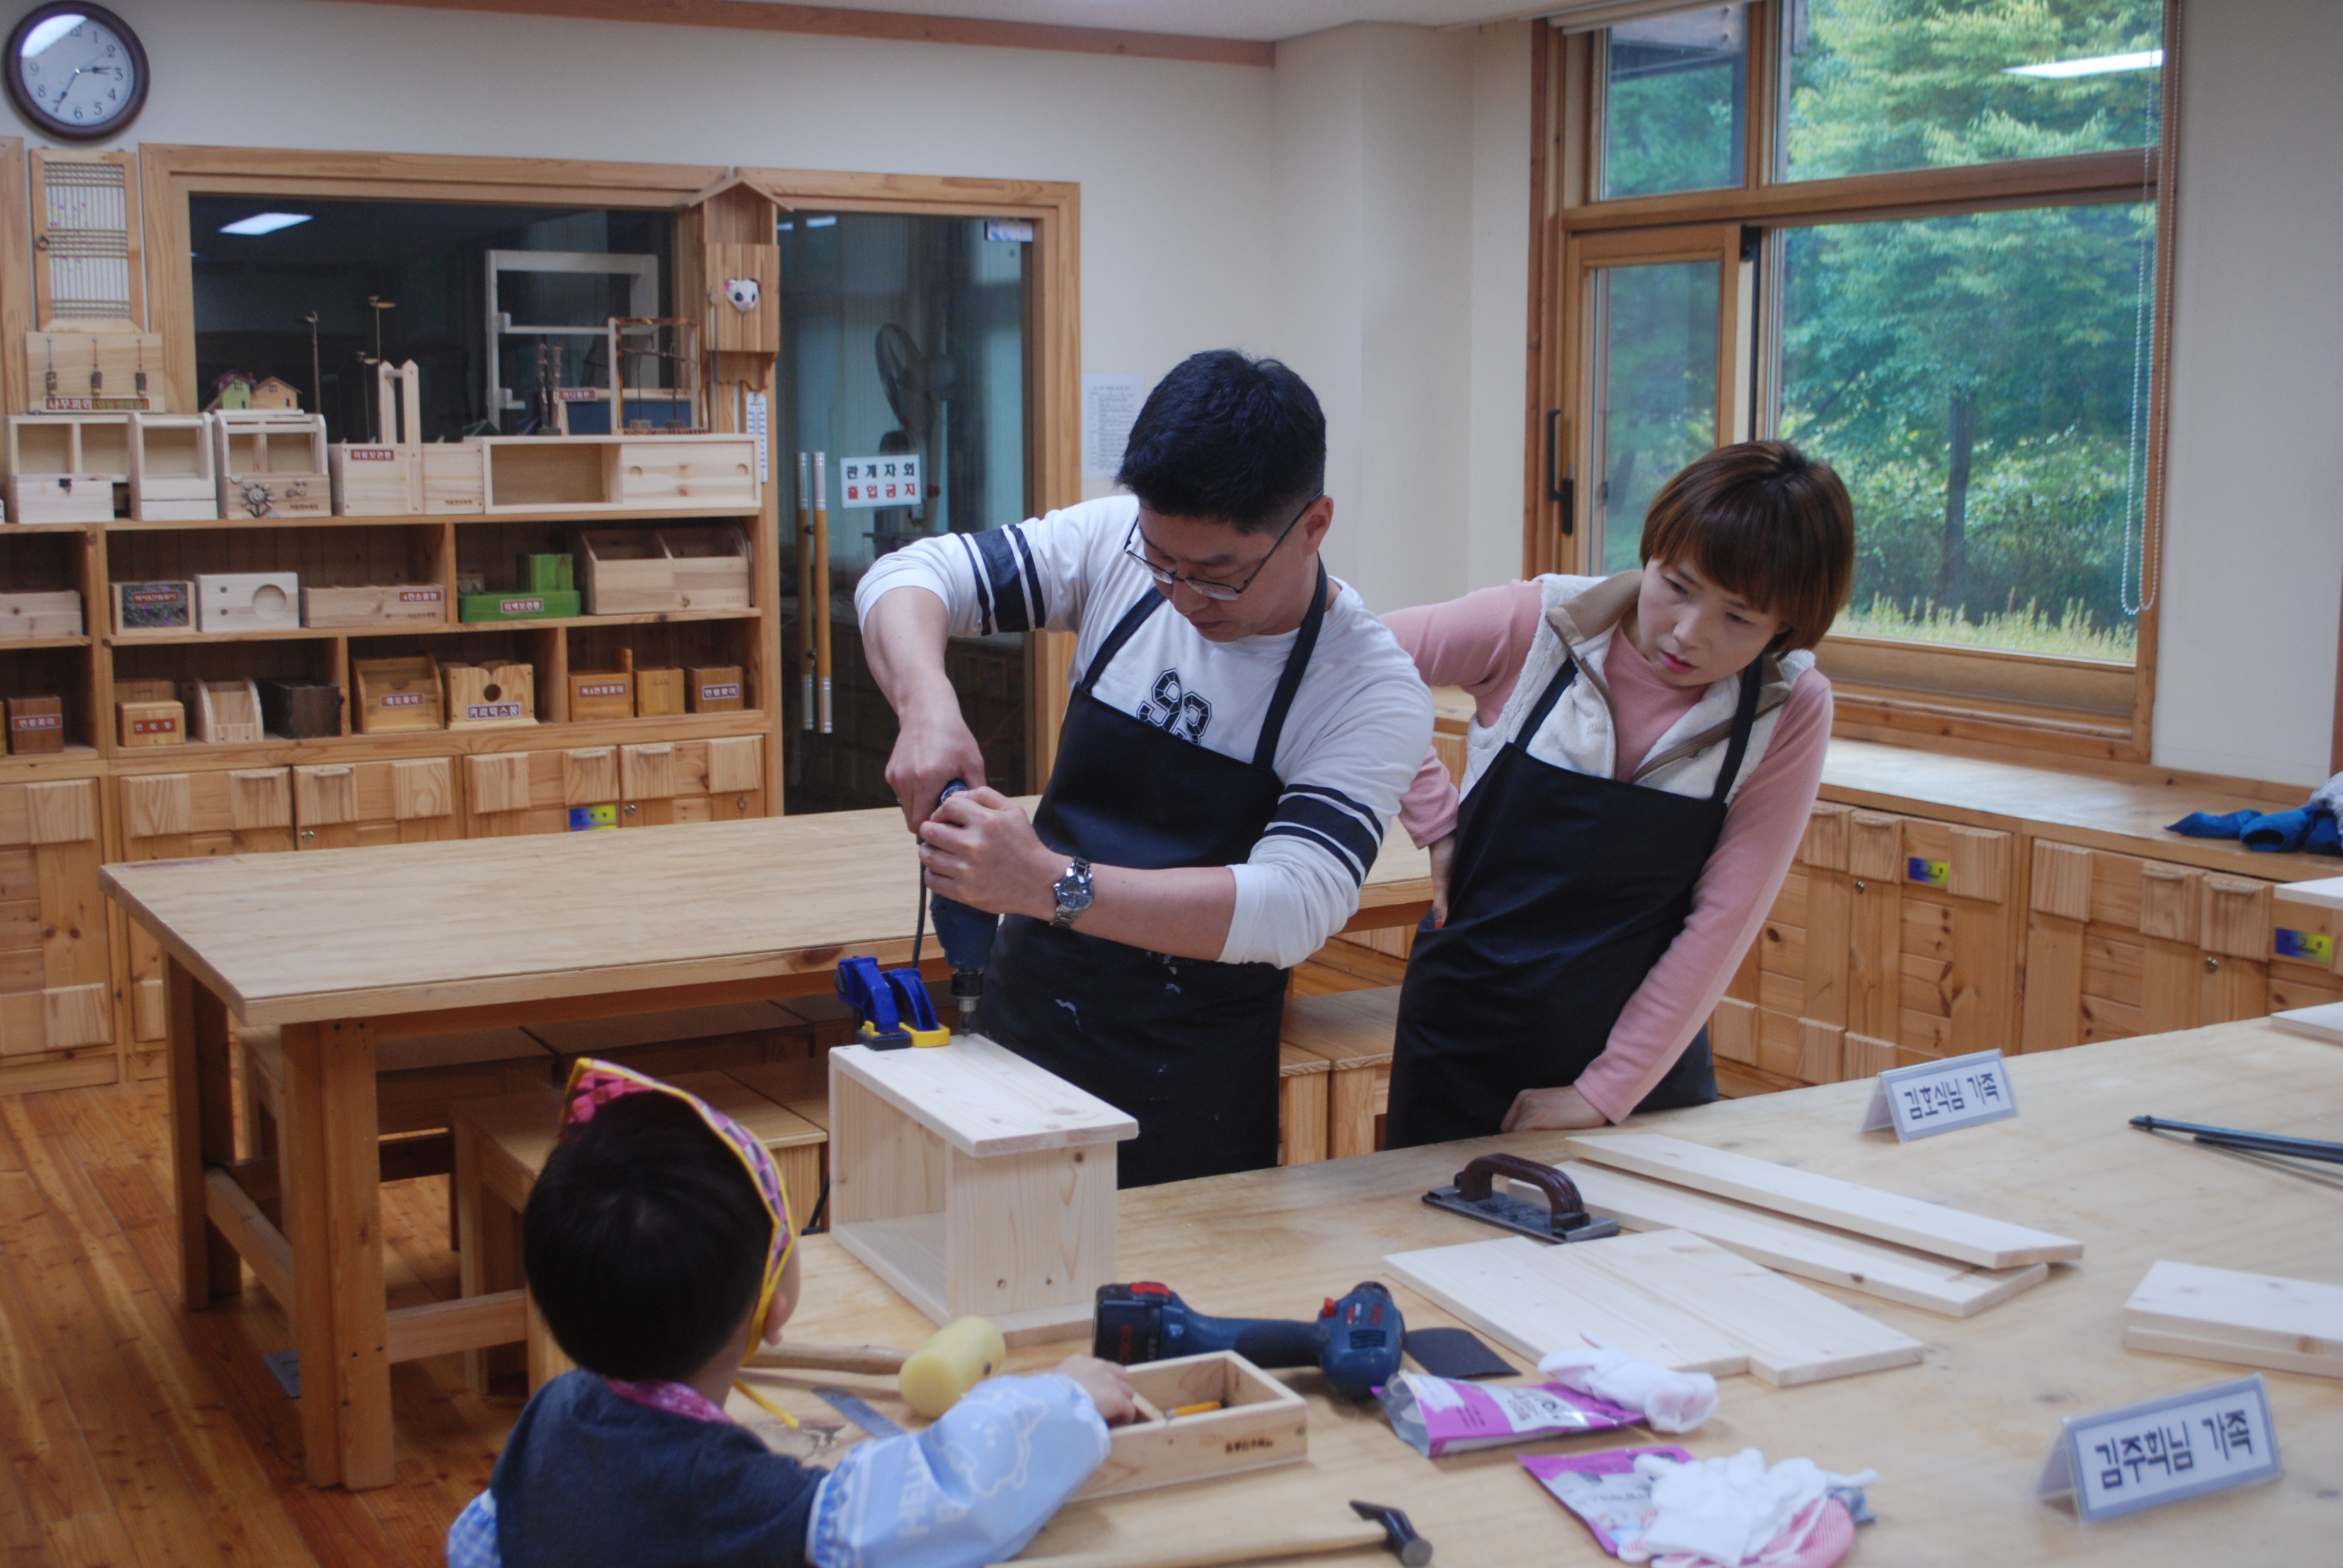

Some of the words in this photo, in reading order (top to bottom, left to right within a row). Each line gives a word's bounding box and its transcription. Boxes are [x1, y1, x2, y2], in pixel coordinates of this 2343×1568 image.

[93, 30, 98, 44] 1
[106, 44, 116, 58] 2
[30, 62, 39, 76] 9
[114, 67, 123, 81] 3
[37, 84, 47, 98] 8
[107, 88, 116, 102] 4
[74, 106, 84, 120] 6
[94, 102, 103, 116] 5
[847, 482, 916, 500] 출입금지
[1904, 1078, 1965, 1120] 김호식님
[1967, 1072, 1999, 1106] 가족
[2094, 1419, 2194, 1490] 김주희님
[2201, 1408, 2253, 1461] 가족
